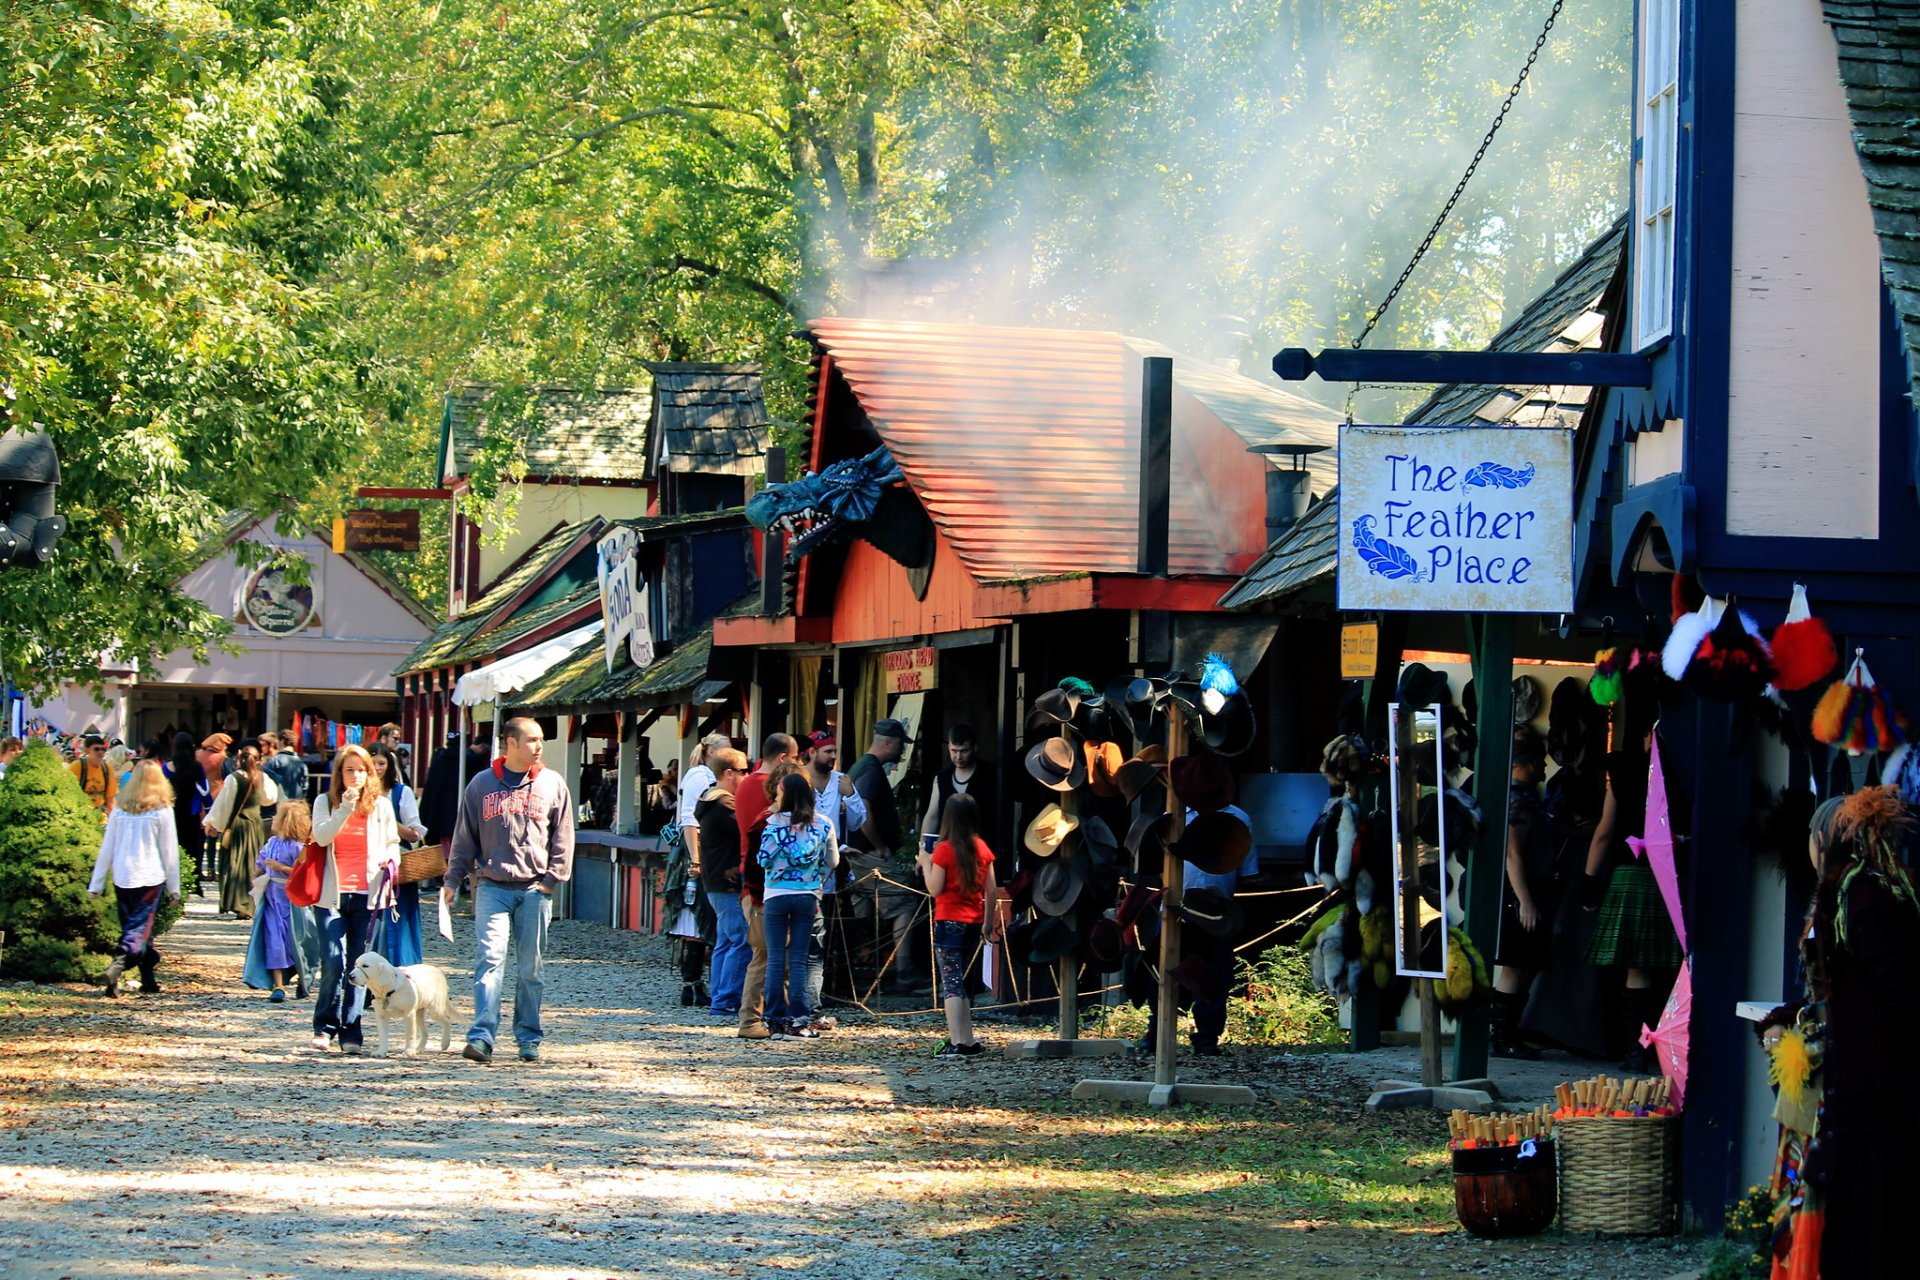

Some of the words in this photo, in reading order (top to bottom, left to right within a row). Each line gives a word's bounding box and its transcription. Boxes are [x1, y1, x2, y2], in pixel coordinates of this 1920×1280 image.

[1385, 454, 1457, 492] The
[1384, 500, 1535, 540] Feather
[1427, 545, 1532, 585] Place
[609, 567, 632, 633] SODA
[258, 615, 295, 630] Squirrel
[897, 671, 921, 692] FORGE
[482, 790, 508, 821] OHIO
